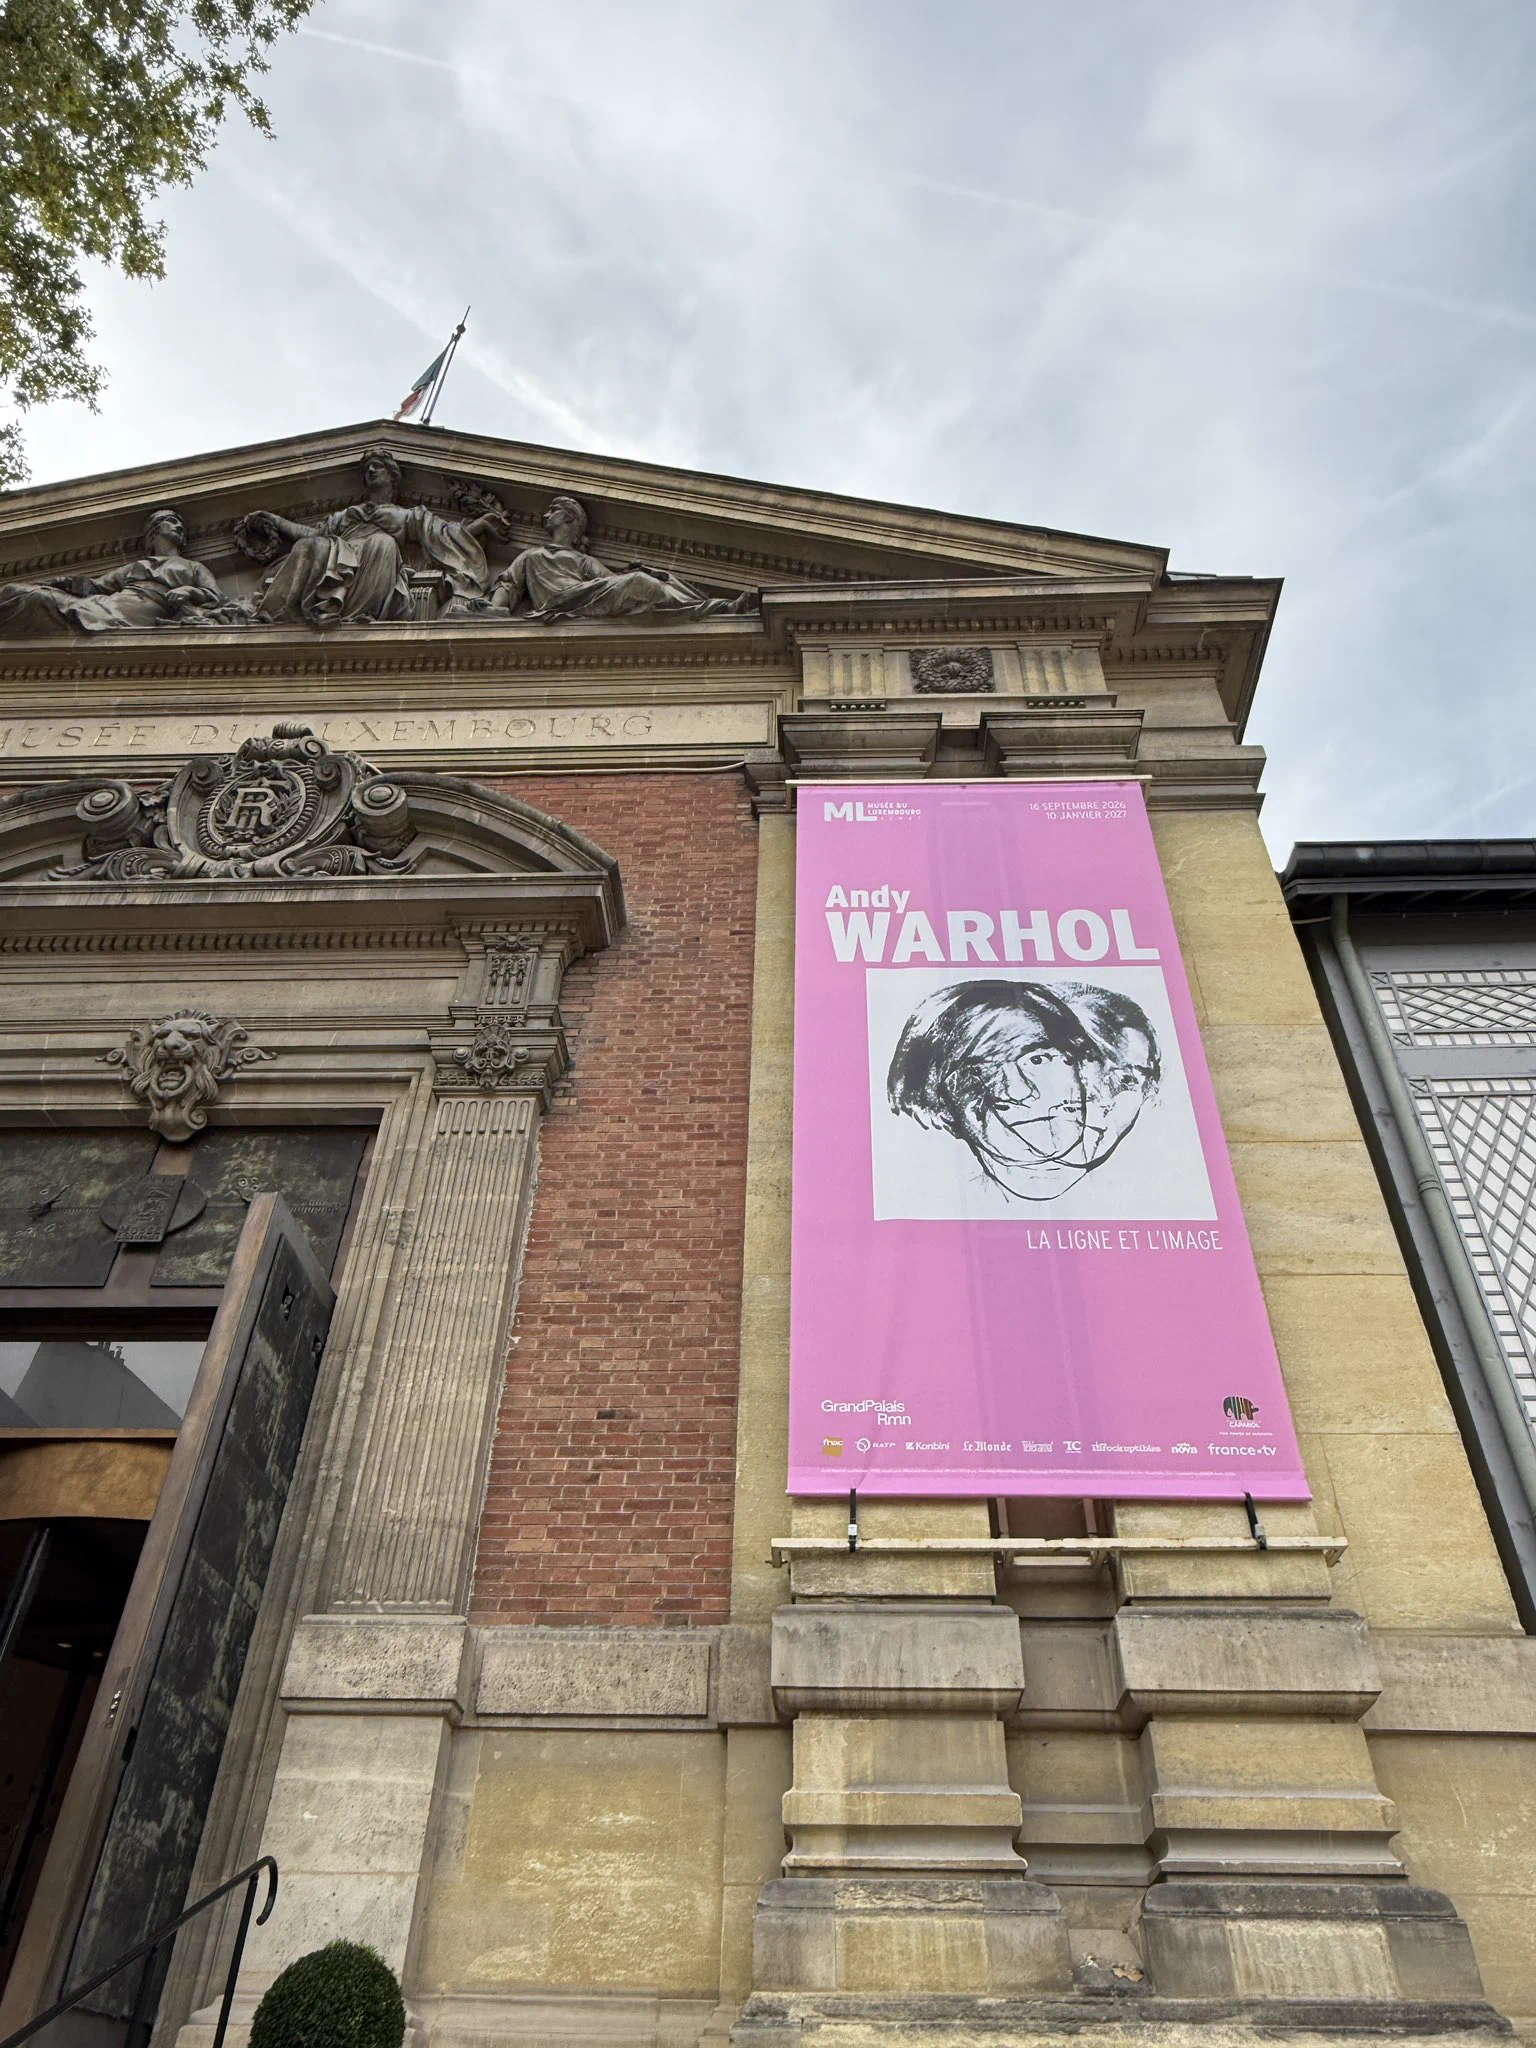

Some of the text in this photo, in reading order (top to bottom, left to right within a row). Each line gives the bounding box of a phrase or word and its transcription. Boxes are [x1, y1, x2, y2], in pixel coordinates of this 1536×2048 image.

[0, 722, 155, 750] USÉE
[321, 715, 653, 743] UXEMBOURG
[824, 802, 877, 821] ML
[1030, 801, 1127, 811] 16 SEPTEMBRE 2026
[1046, 810, 1127, 820] 10 JANVIER 2027
[825, 884, 911, 914] Andy
[825, 909, 1161, 963] WARHOL
[1027, 1230, 1224, 1250] LA LIGNE ET L'IMAGE
[821, 1399, 905, 1413] GrandPalais
[877, 1413, 912, 1426] Rmn
[823, 1439, 843, 1447] fnac
[915, 1442, 950, 1450] Konbini
[962, 1441, 974, 1452] Le
[975, 1441, 1012, 1452] Monde
[1171, 1445, 1198, 1454] nova
